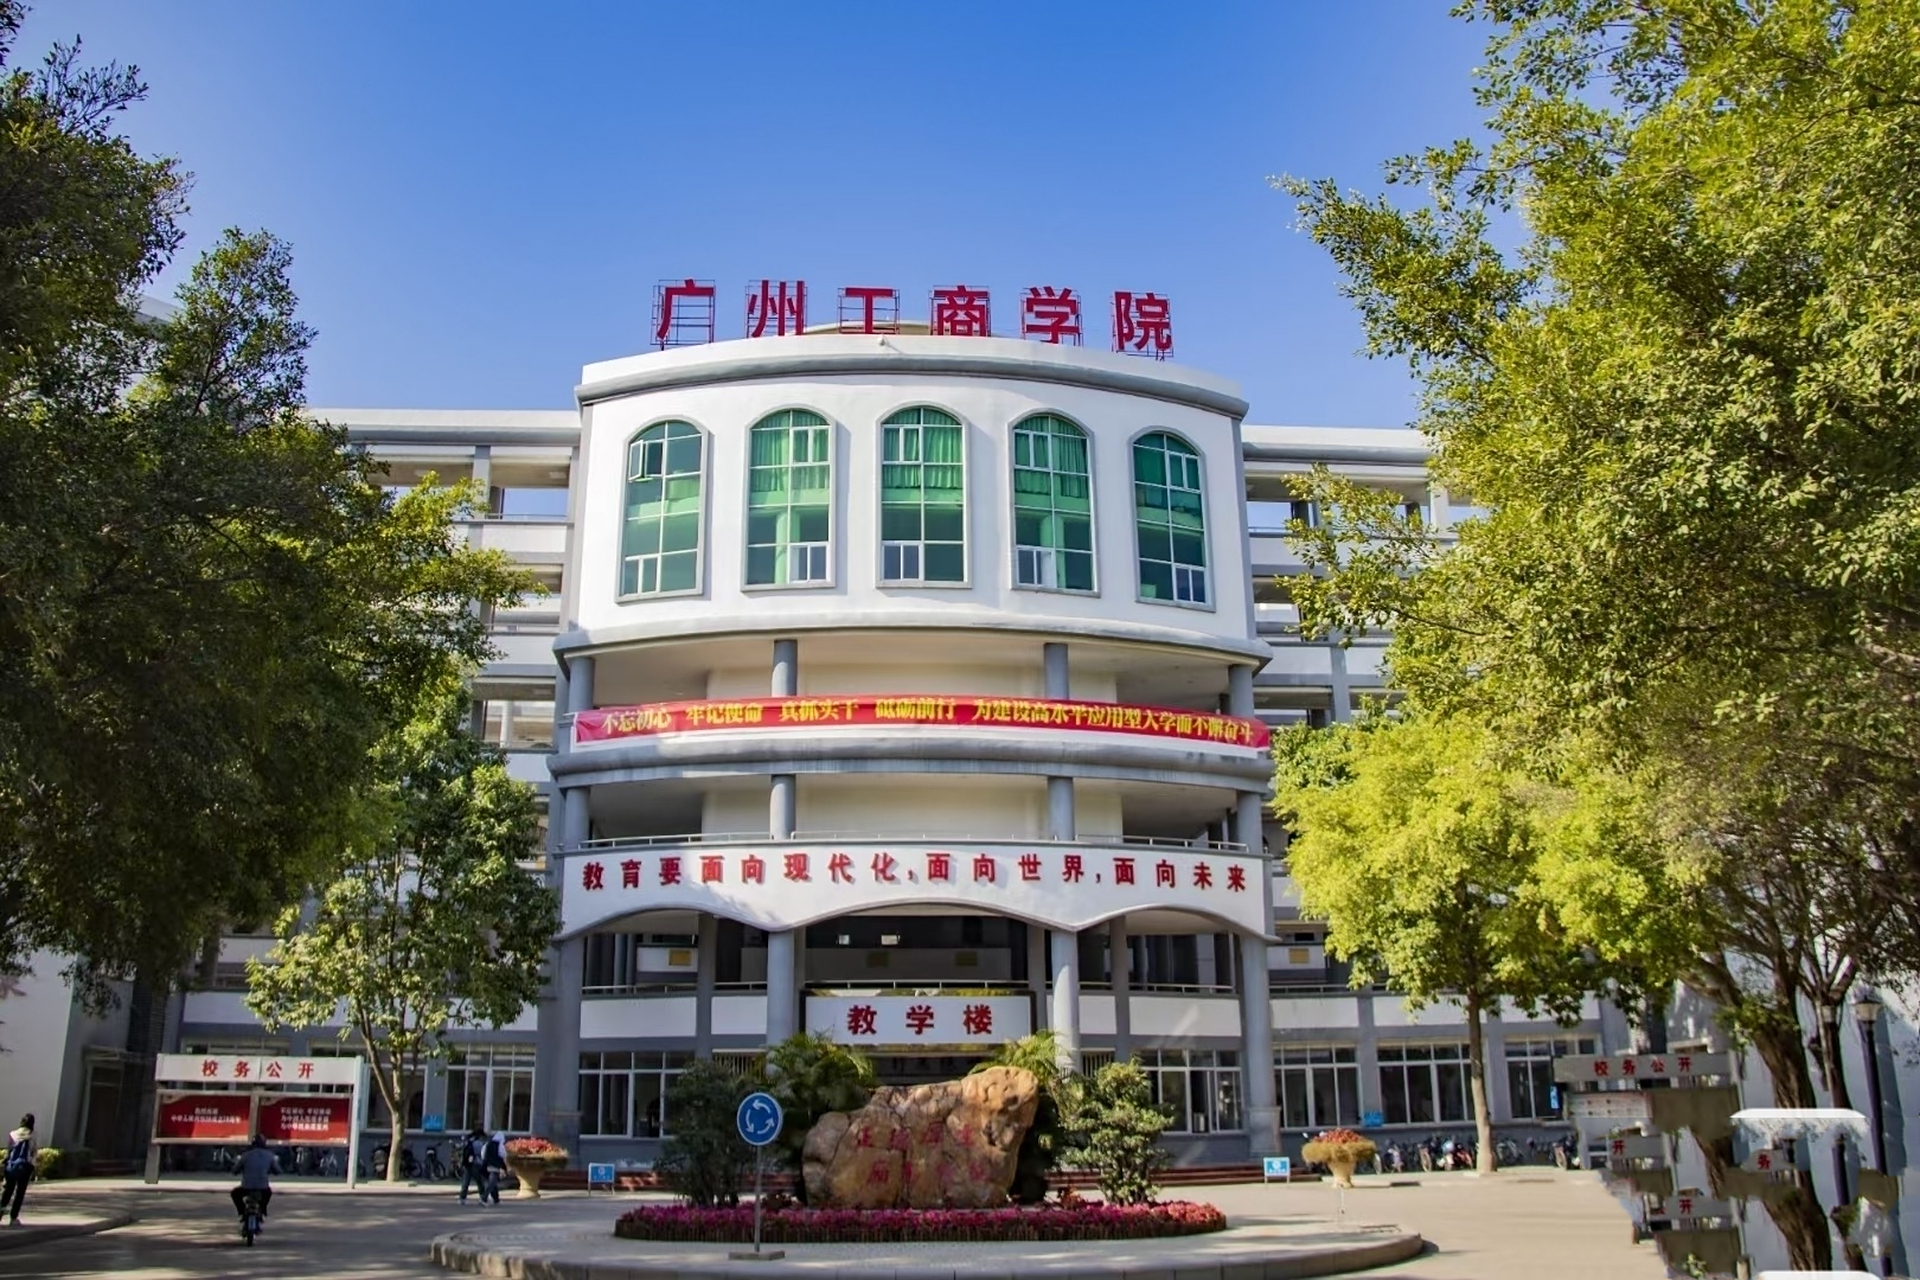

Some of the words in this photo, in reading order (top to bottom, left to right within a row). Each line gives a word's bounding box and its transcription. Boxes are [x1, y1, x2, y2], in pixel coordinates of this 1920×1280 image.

[657, 279, 1173, 351] 广州工商学院
[602, 708, 671, 734] 不忘初心
[686, 702, 763, 725] 牢记使命
[779, 699, 858, 721] 真抓实干
[875, 698, 956, 719] 砥砺前行
[847, 1005, 993, 1035] 教学楼
[202, 1060, 314, 1078] 校务公开
[1594, 1056, 1692, 1076] 校务公开
